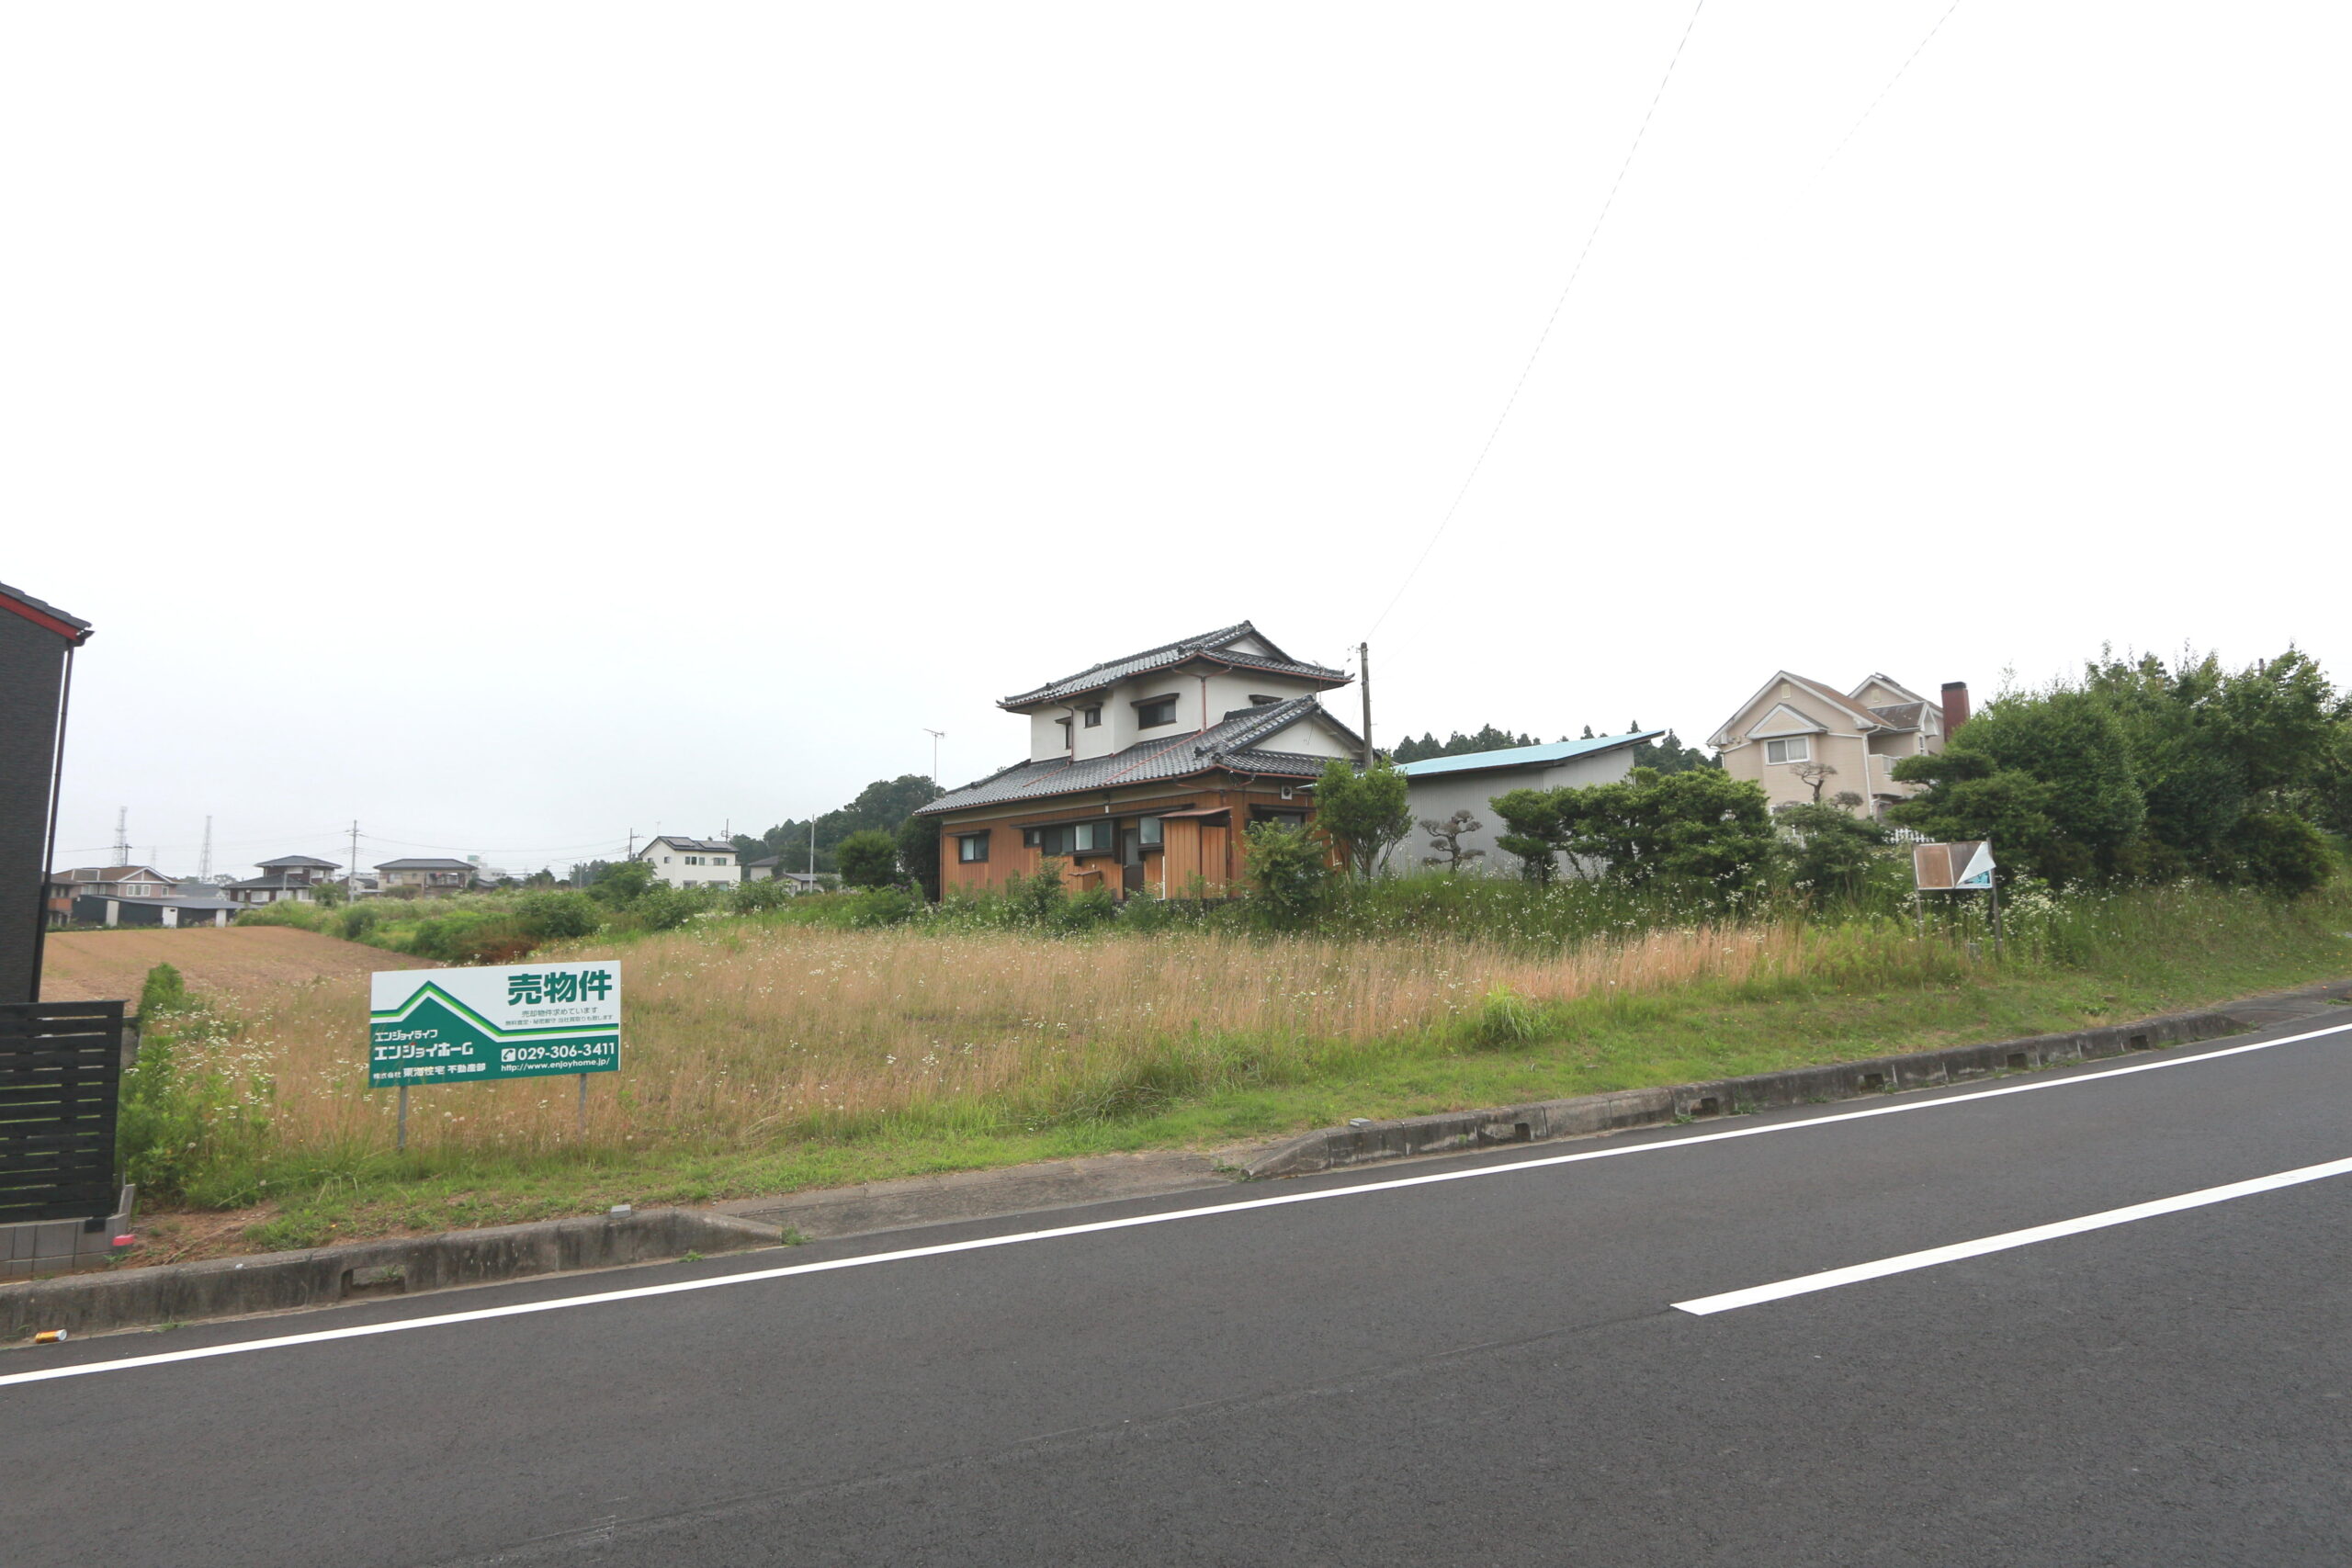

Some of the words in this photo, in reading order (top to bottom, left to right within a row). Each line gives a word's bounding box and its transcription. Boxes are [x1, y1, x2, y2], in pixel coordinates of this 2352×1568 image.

[507, 970, 613, 1006] 売物件
[521, 1007, 598, 1018] 売却物件求めています
[375, 1029, 438, 1042] エンジョイライフ
[374, 1042, 473, 1061] エンジョイホーム
[517, 1043, 615, 1061] 029-306-3411
[501, 1057, 610, 1073] http://www.enjoyhome.jp/
